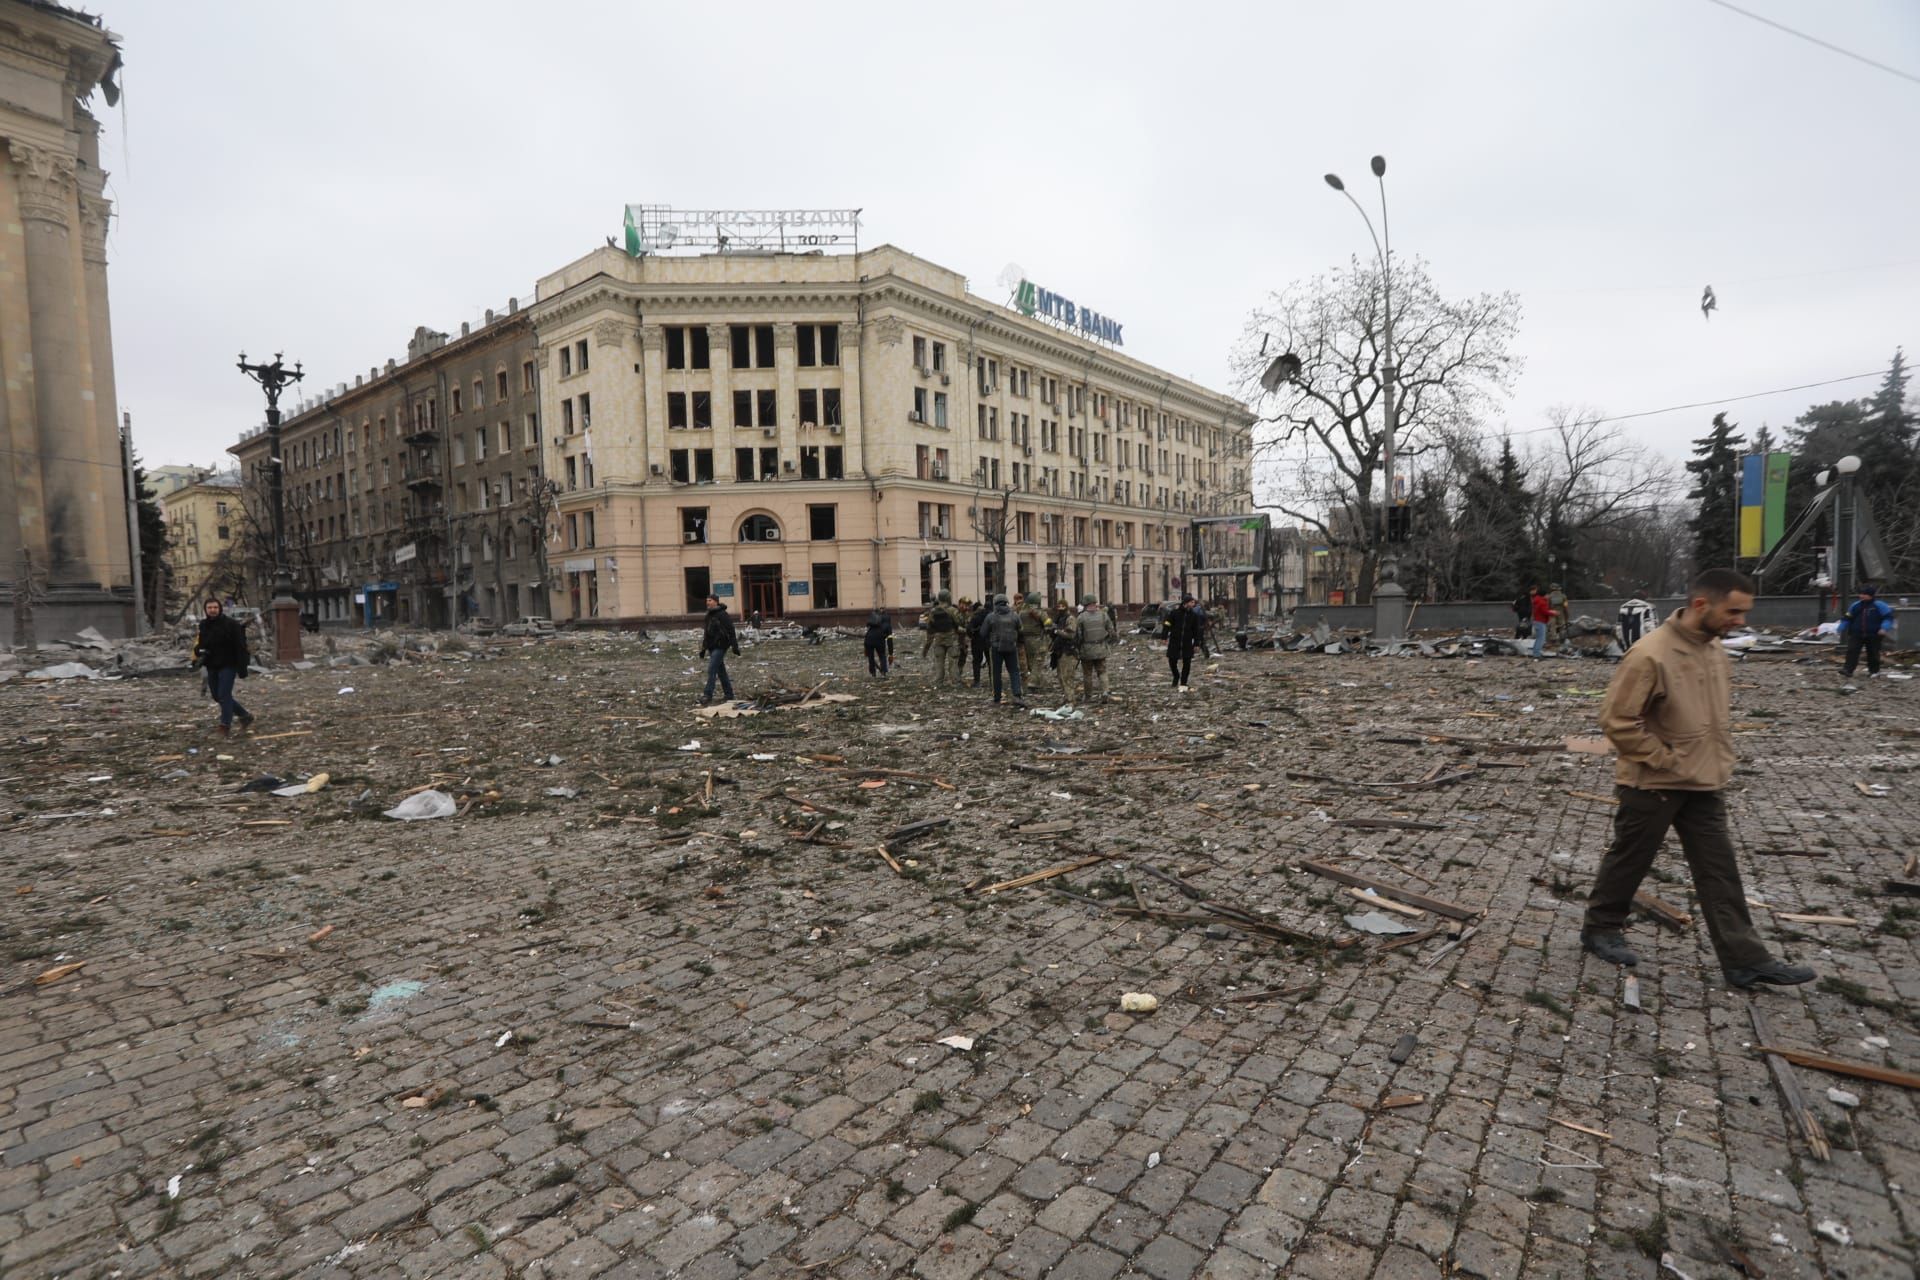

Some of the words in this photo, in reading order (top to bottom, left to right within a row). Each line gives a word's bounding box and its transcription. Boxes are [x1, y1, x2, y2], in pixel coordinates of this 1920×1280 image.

[684, 209, 864, 229] UKRSIBBANK
[1038, 286, 1076, 326] MTB
[1080, 305, 1123, 346] BANK
